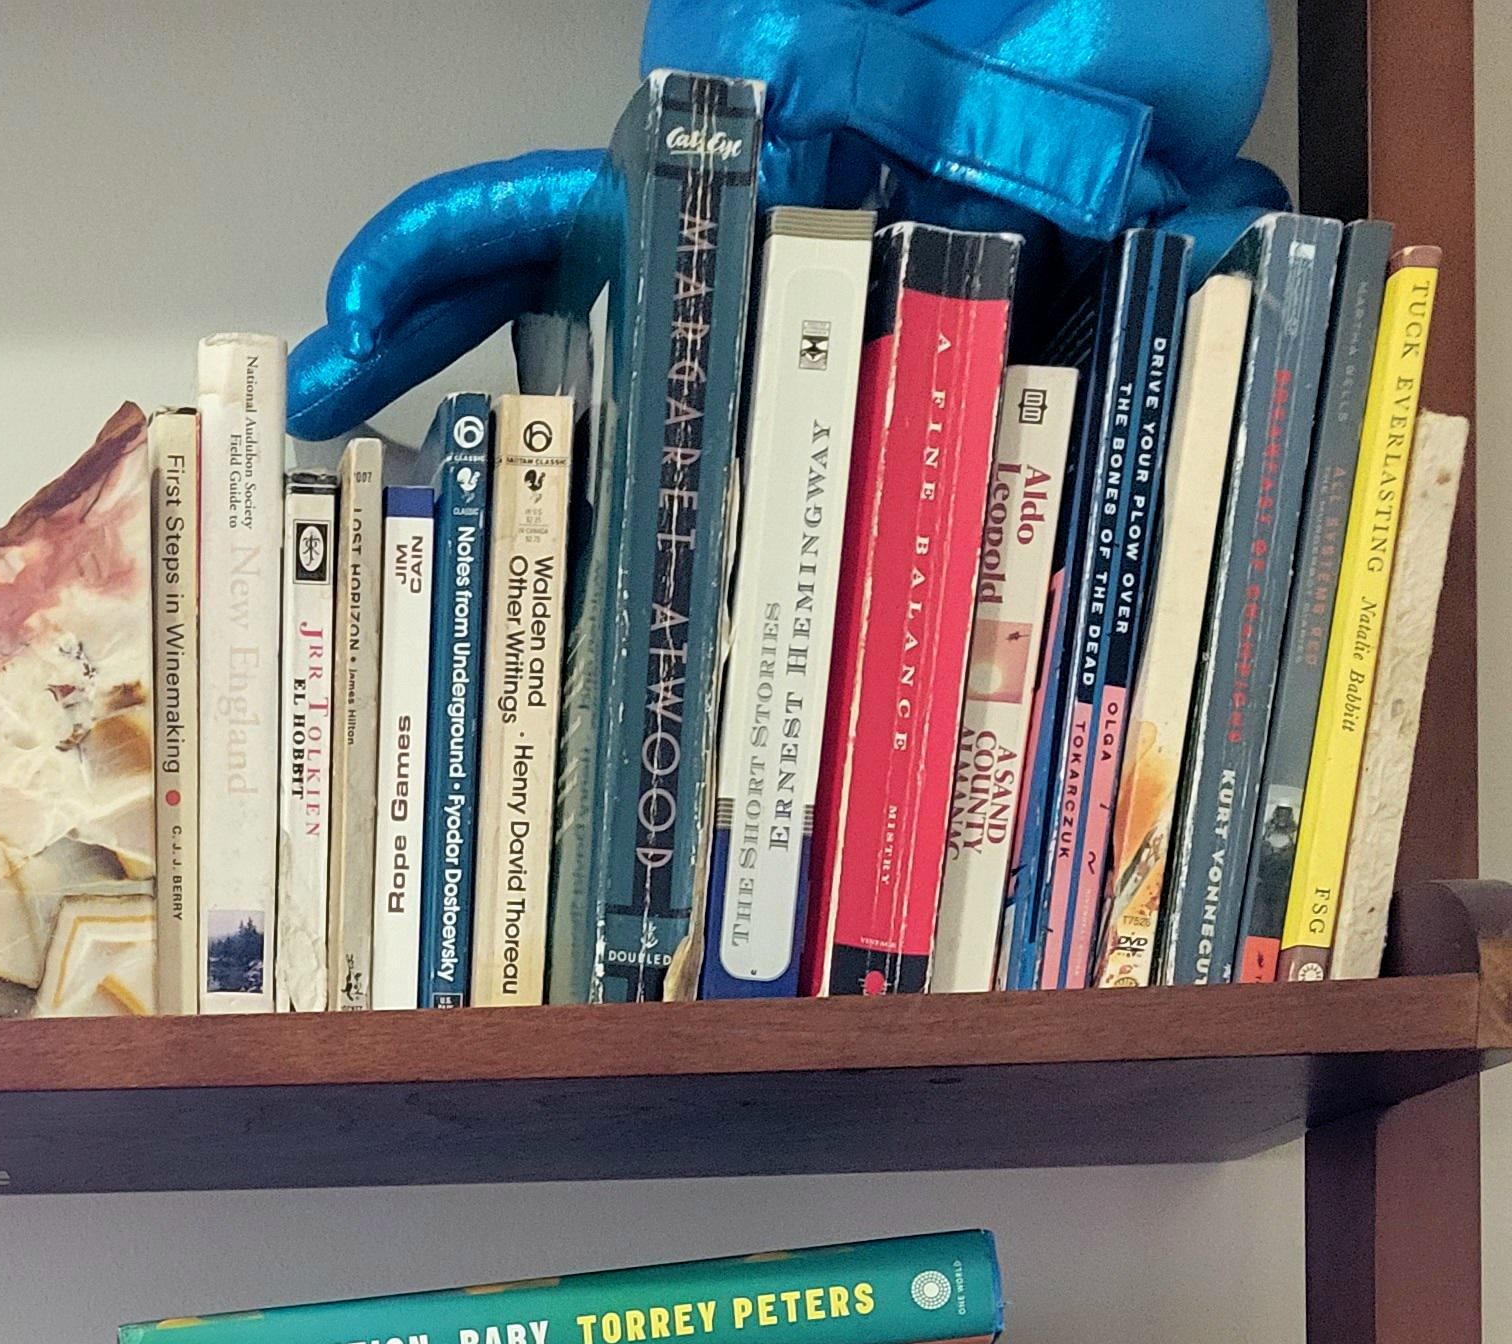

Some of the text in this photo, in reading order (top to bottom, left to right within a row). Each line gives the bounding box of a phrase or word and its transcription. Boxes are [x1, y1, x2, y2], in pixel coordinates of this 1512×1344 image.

[161, 454, 186, 774] First Steps in Winemaking
[527, 558, 554, 707] Walden and
[637, 214, 716, 868] MARGARET ATWOOD
[881, 334, 952, 885] A FINE BALANCE MISTRY
[1081, 383, 1133, 687] THE BONES OF THE DEAD
[1116, 338, 1167, 635] DRIVE YOUR PLOW OVER
[1307, 280, 1431, 936] TUCK EVERLASTING Natalie Babbitt FSG
[292, 678, 307, 799] EL HOBBIT
[306, 699, 329, 837] TOLKIEN
[388, 716, 411, 913] Rope Games
[436, 526, 475, 981] Notes from Underground Fyodor Dostoevsky
[501, 556, 534, 994] Other Writings Henry David Thoreau
[1058, 702, 1118, 859] OLGA TOKARCZUK
[733, 1283, 875, 1327] PETERS
